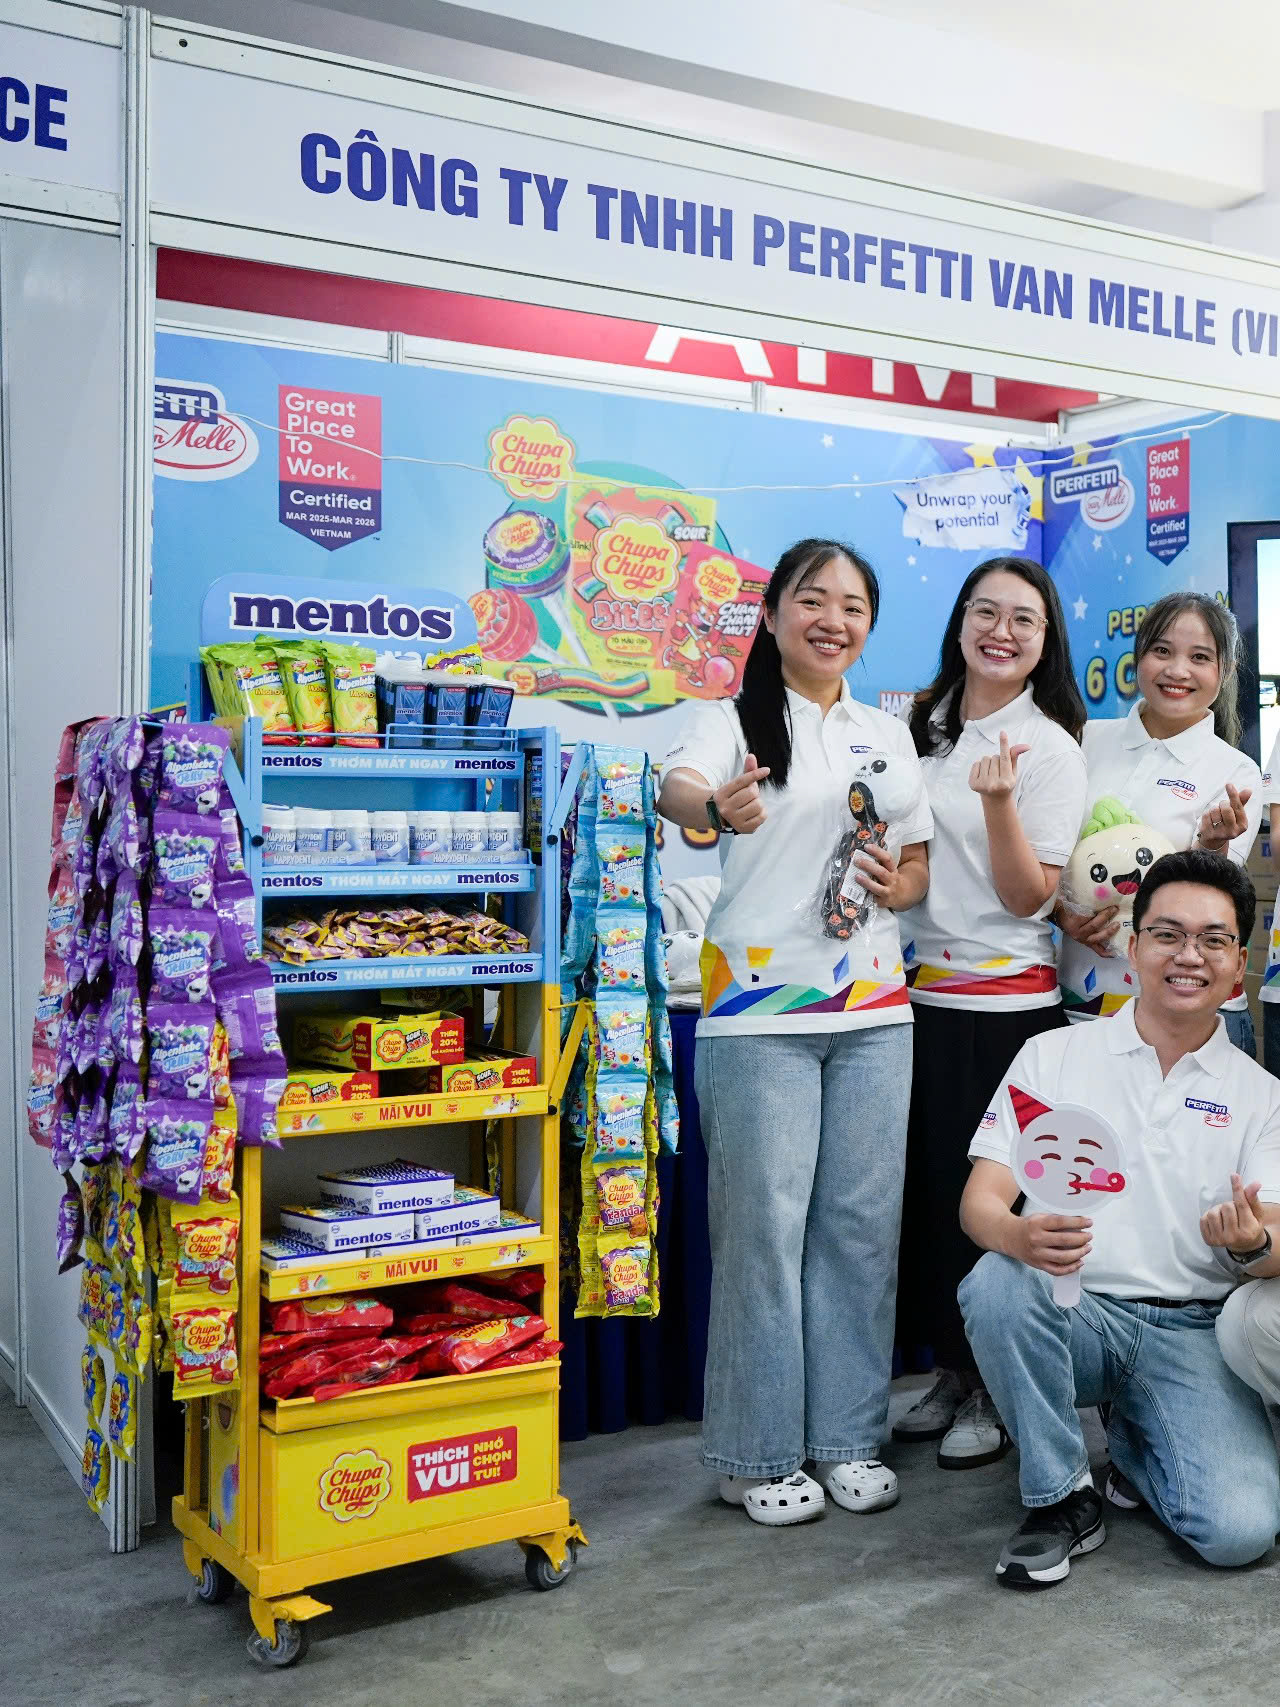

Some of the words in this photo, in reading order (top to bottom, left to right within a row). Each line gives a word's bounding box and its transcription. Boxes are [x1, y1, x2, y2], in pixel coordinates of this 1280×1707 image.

[300, 128, 479, 219] CÔNG
[500, 167, 569, 232] TY
[587, 184, 733, 261] TNHH
[752, 217, 973, 302] PERFETTI
[989, 258, 1074, 319] VAN
[1088, 278, 1217, 345] MELLE
[285, 392, 357, 418] Great
[172, 417, 237, 452] Melle
[287, 413, 356, 439] Place
[285, 435, 313, 455] To
[502, 434, 564, 460] Chupa
[1148, 446, 1180, 465] Great
[499, 454, 561, 486] Chups
[1149, 465, 1180, 481] Place
[1055, 469, 1117, 495] PERFETTI
[1149, 482, 1161, 496] To
[289, 489, 372, 511] Certified
[916, 492, 976, 510] Unwrap
[980, 493, 1013, 508] your
[286, 511, 307, 521] MAR
[309, 513, 353, 525] 2025-MAR
[355, 516, 376, 527] 2026
[935, 511, 999, 532] potential
[1150, 518, 1186, 535] Certified
[310, 528, 352, 539] VIETNAM
[673, 525, 708, 541] SOUR
[608, 534, 671, 563] Chupa
[603, 554, 666, 588] Chups
[233, 595, 452, 640] mentos
[1086, 656, 1106, 701] 6
[409, 758, 450, 770] NGAY
[454, 757, 516, 770] mentos
[410, 874, 451, 887] NGAY
[457, 870, 520, 884] mentos
[272, 969, 338, 984] mentos
[426, 965, 465, 979] NGAY
[471, 961, 534, 976] mentos
[383, 1039, 402, 1048] Chupa
[439, 1038, 458, 1047] 20%
[511, 1077, 530, 1085] 20%
[351, 1092, 371, 1100] 20%
[403, 1103, 432, 1119] VUI
[1186, 1099, 1226, 1114] PERFETTI
[608, 1183, 634, 1198] Chupa
[608, 1192, 635, 1206] Chups
[377, 1196, 433, 1211] mentos
[426, 1218, 480, 1237] mentos
[190, 1233, 222, 1247] Chupa
[334, 1231, 392, 1247] mentos
[188, 1242, 221, 1257] Chups
[408, 1258, 438, 1275] VUI
[613, 1263, 638, 1277] Chupa
[613, 1271, 639, 1285] Chups
[189, 1325, 222, 1339] Chupa
[187, 1334, 220, 1349] Chups
[412, 1444, 469, 1468] THÍCH
[329, 1465, 384, 1488] Chupa
[414, 1460, 470, 1492] VUI
[472, 1449, 513, 1467] CHỌN
[473, 1466, 501, 1481] TUI!
[326, 1482, 381, 1510] Chups
